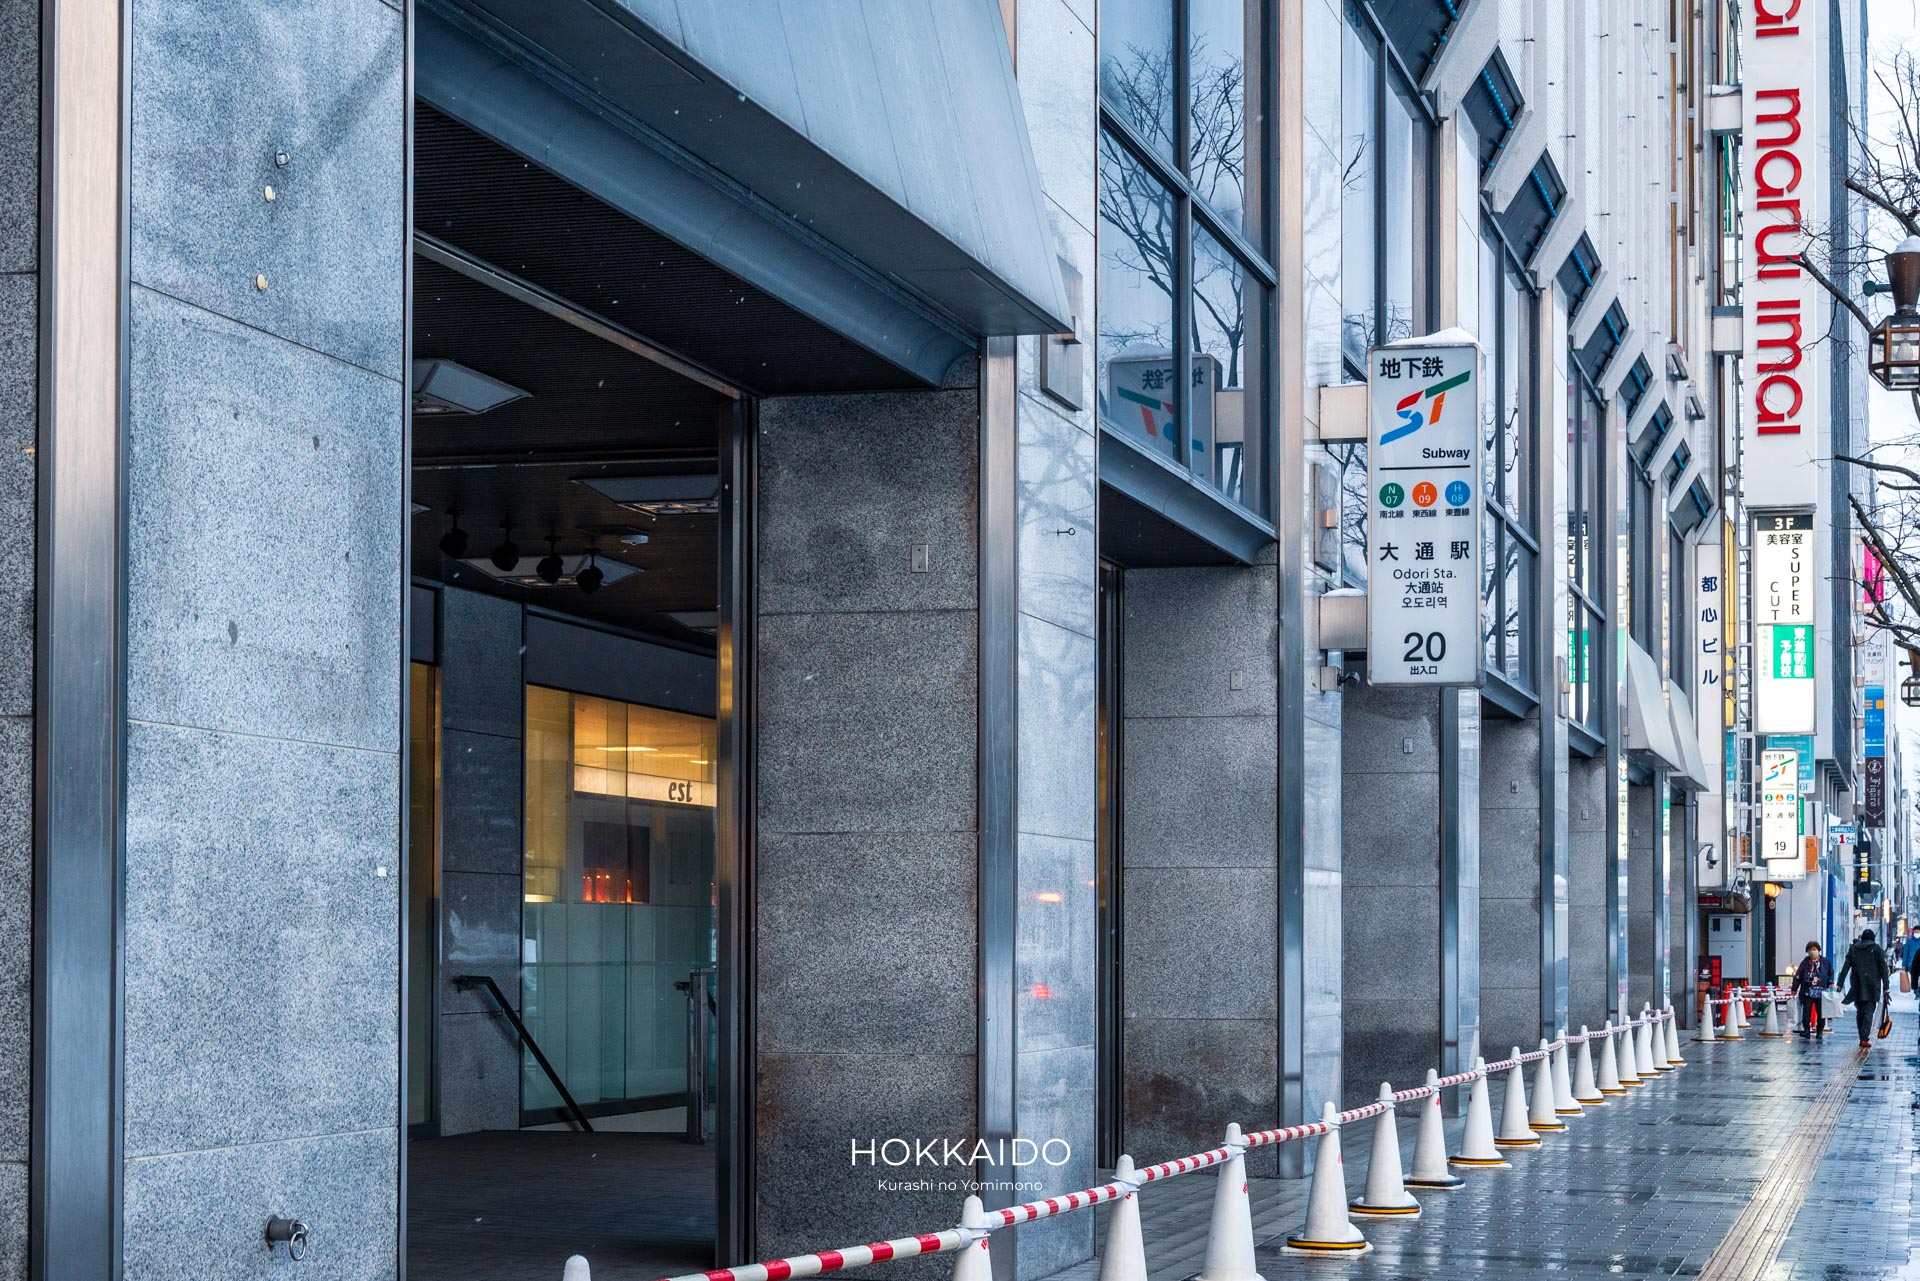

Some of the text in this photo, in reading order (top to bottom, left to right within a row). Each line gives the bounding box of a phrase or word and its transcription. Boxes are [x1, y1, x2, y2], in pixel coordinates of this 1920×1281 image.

[1755, 88, 1803, 436] marui imai
[1379, 356, 1444, 379] 地下鉄
[1422, 447, 1471, 461] Subway
[1388, 486, 1396, 494] N
[1421, 485, 1428, 493] T
[1454, 484, 1461, 492] H
[1385, 496, 1398, 504] 07
[1418, 495, 1431, 503] 09
[1379, 510, 1404, 518] 南北線
[1412, 509, 1437, 517] 東西線
[1445, 508, 1470, 517] 東豊線
[1774, 517, 1794, 530] 3F
[1767, 533, 1803, 546] 美容室
[1379, 541, 1470, 561] 大通駅
[1393, 568, 1457, 580] Odori Sta.
[1405, 581, 1444, 594] 大通站
[1790, 547, 1801, 616] SUPER
[1401, 596, 1447, 609] 오도리역
[1770, 581, 1780, 621] CUT
[1701, 576, 1718, 685] 都心ビル
[1403, 631, 1446, 662] 20
[1410, 665, 1438, 676] 出入口
[669, 780, 693, 802] est
[1839, 834, 1845, 844] 1
[1774, 841, 1787, 851] 19
